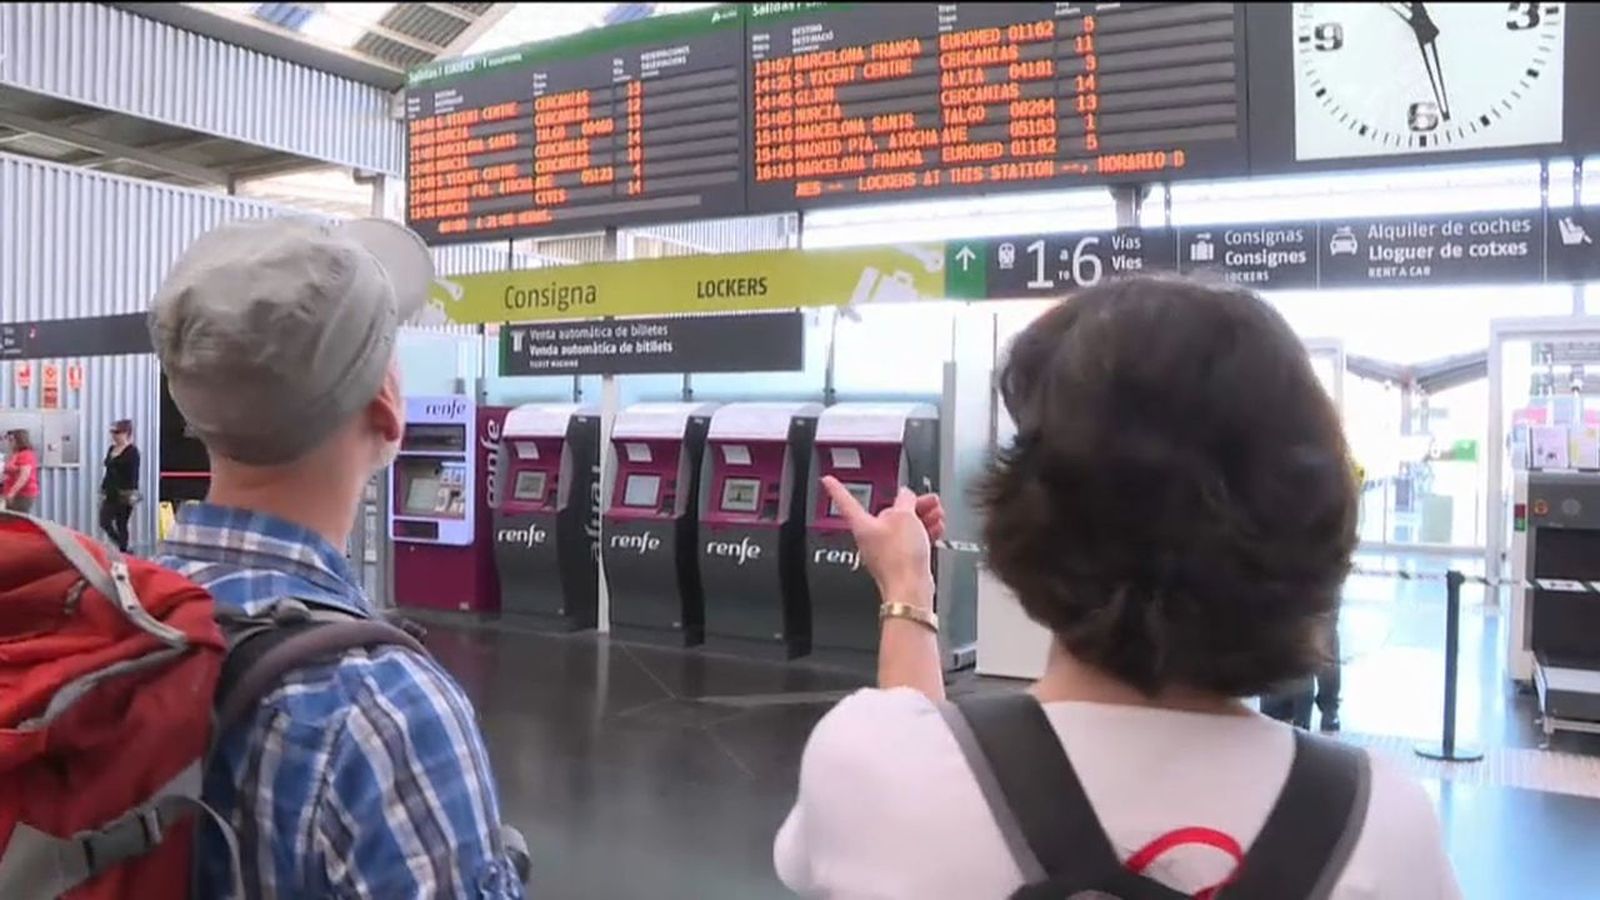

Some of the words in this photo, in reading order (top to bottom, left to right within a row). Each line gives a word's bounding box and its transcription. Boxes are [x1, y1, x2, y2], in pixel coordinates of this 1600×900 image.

[1506, 2, 1541, 31] 3
[794, 46, 865, 71] BARCELONA
[940, 28, 1000, 50] EUROMED
[1314, 22, 1343, 51] 9
[794, 72, 804, 89] S
[810, 65, 856, 85] VICENT
[940, 45, 1019, 69] CERCANIAS
[1075, 35, 1094, 53] 11
[941, 68, 985, 88] ALVIA
[795, 103, 841, 124] MURCIA
[941, 83, 1019, 106] CERCANIAS
[1075, 74, 1095, 92] 14
[795, 117, 866, 142] BARCELONA
[872, 112, 914, 132] SANTS
[942, 106, 986, 125] TALGO
[1407, 102, 1439, 131] 6
[795, 138, 841, 159] MADRID
[888, 128, 939, 149] ATOCHA
[942, 126, 968, 144] AVE
[1084, 113, 1095, 131] 1
[795, 154, 866, 177] BARCELONA
[942, 142, 1004, 163] EUROMED
[858, 173, 917, 192] LOCKERS
[922, 170, 941, 187] AT
[951, 165, 983, 184] THIS
[990, 160, 1054, 181] STATION
[1097, 152, 1166, 173] HORARIO
[1112, 234, 1141, 250] Vías
[1224, 229, 1304, 247] Consignas
[1368, 222, 1436, 243] Alquiler
[1445, 220, 1463, 236] de
[1469, 216, 1532, 235] coches
[1027, 239, 1054, 289] 1
[1060, 249, 1069, 260] a
[1073, 237, 1102, 287] 6
[1112, 255, 1142, 271] Vies
[1225, 248, 1306, 269] Consignes
[1369, 242, 1432, 264] Lloguer
[1440, 241, 1462, 259] de
[1469, 241, 1528, 257] cotxes
[1225, 270, 1269, 283] LOCKERS
[1368, 267, 1397, 278] RENT
[1399, 267, 1407, 277] A
[1409, 266, 1431, 277] CAR
[504, 282, 597, 311] Consigna
[697, 276, 768, 299] LOCKERS
[529, 329, 556, 341] Venta
[615, 325, 628, 337] de
[631, 324, 668, 337] billetes
[529, 343, 558, 356] Venda
[619, 341, 632, 355] de
[425, 399, 466, 419] renfe
[481, 419, 500, 508] renfe
[498, 524, 546, 548] renfe
[610, 530, 660, 554] renfe
[706, 537, 761, 565] renfe
